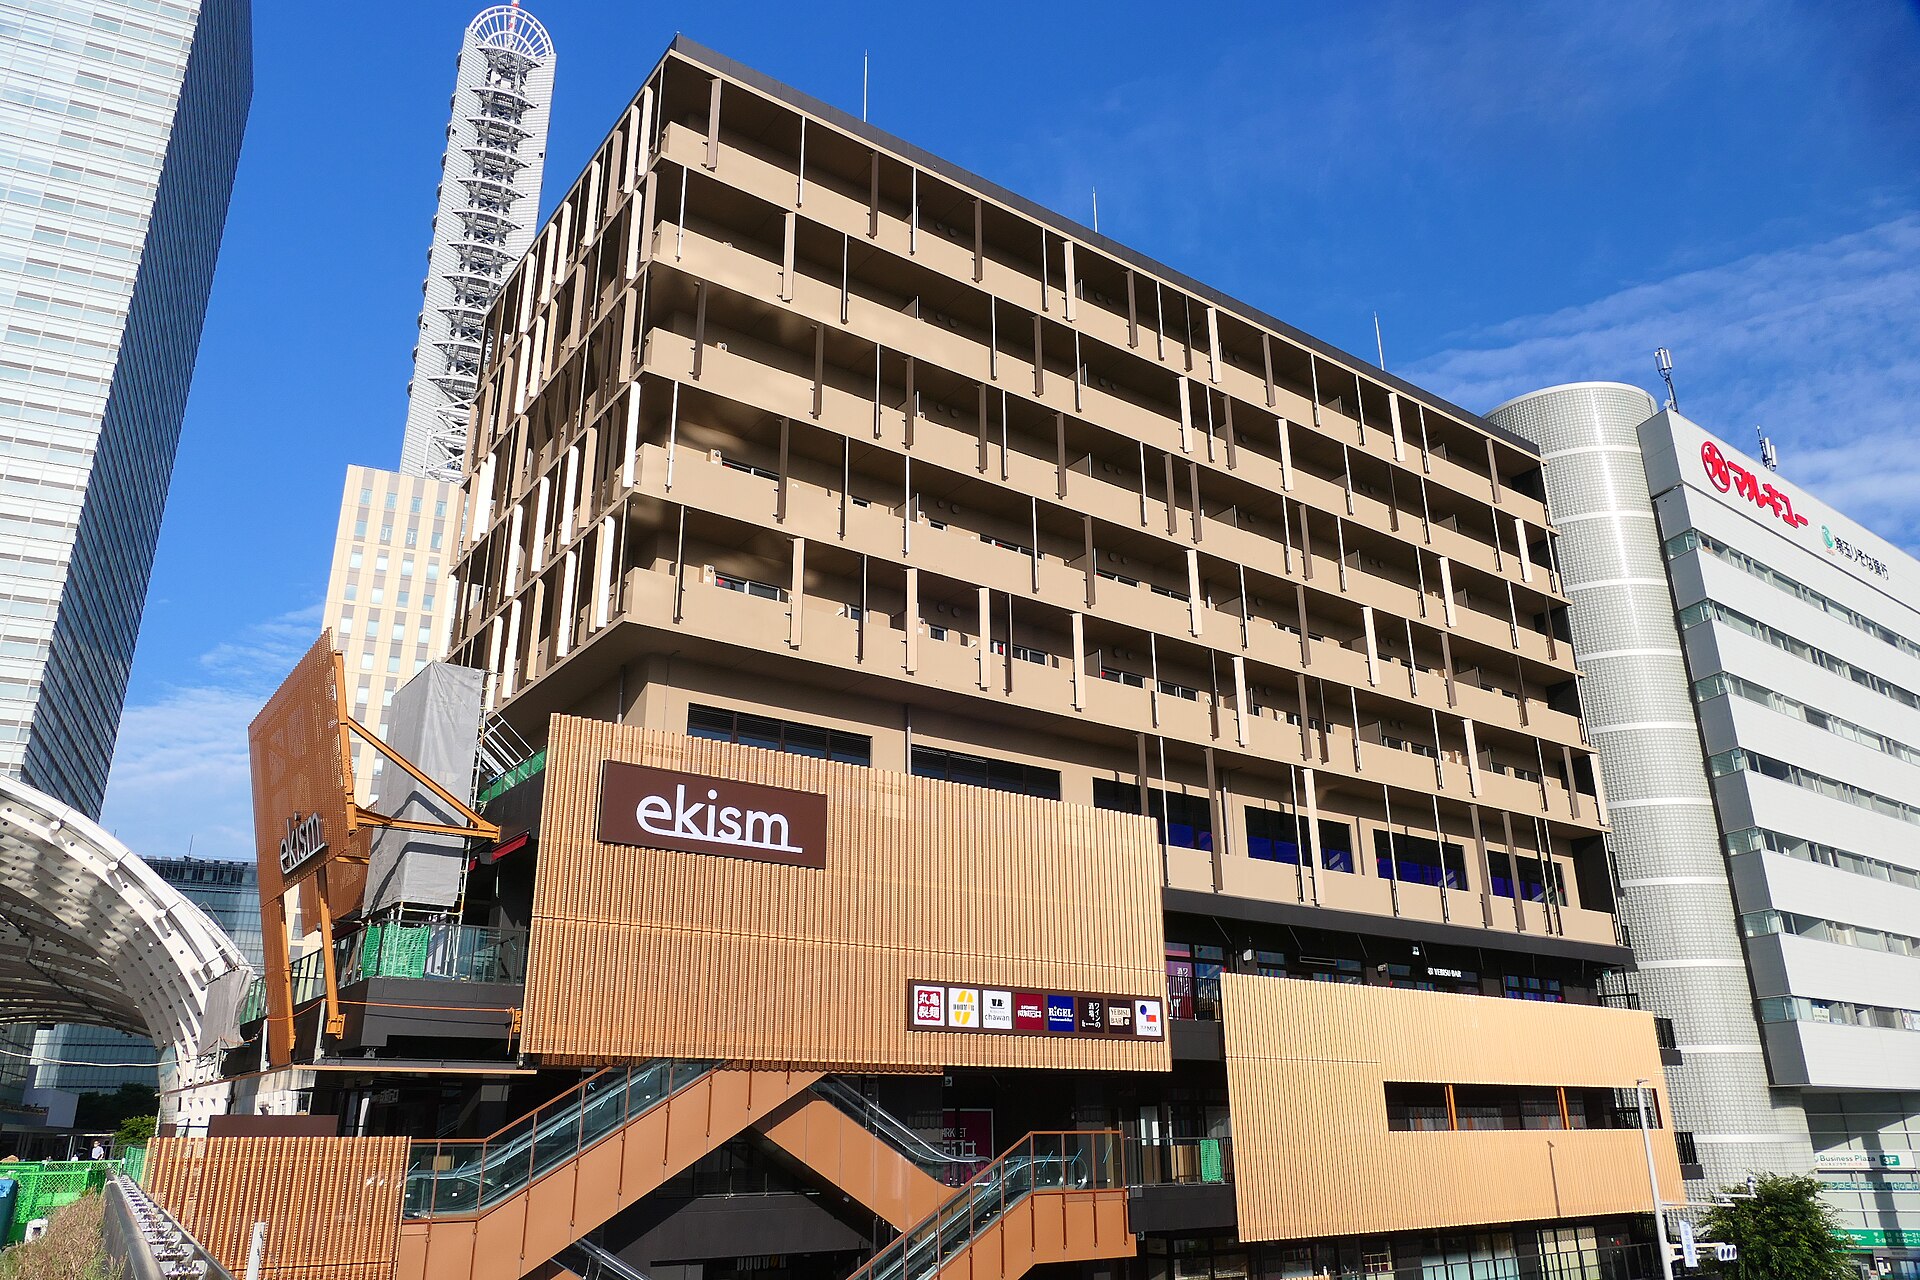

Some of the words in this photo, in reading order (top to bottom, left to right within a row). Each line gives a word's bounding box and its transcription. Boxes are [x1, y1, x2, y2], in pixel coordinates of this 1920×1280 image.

[1727, 461, 1809, 529] マルキュー
[1834, 535, 1889, 581] 埼玉りそな銀行
[280, 811, 327, 875] ekism
[636, 784, 803, 853] ekism
[984, 1012, 1010, 1022] chawan
[1820, 1154, 1853, 1162] Business
[1854, 1154, 1876, 1162] Plaza
[1883, 1156, 1897, 1165] 3F
